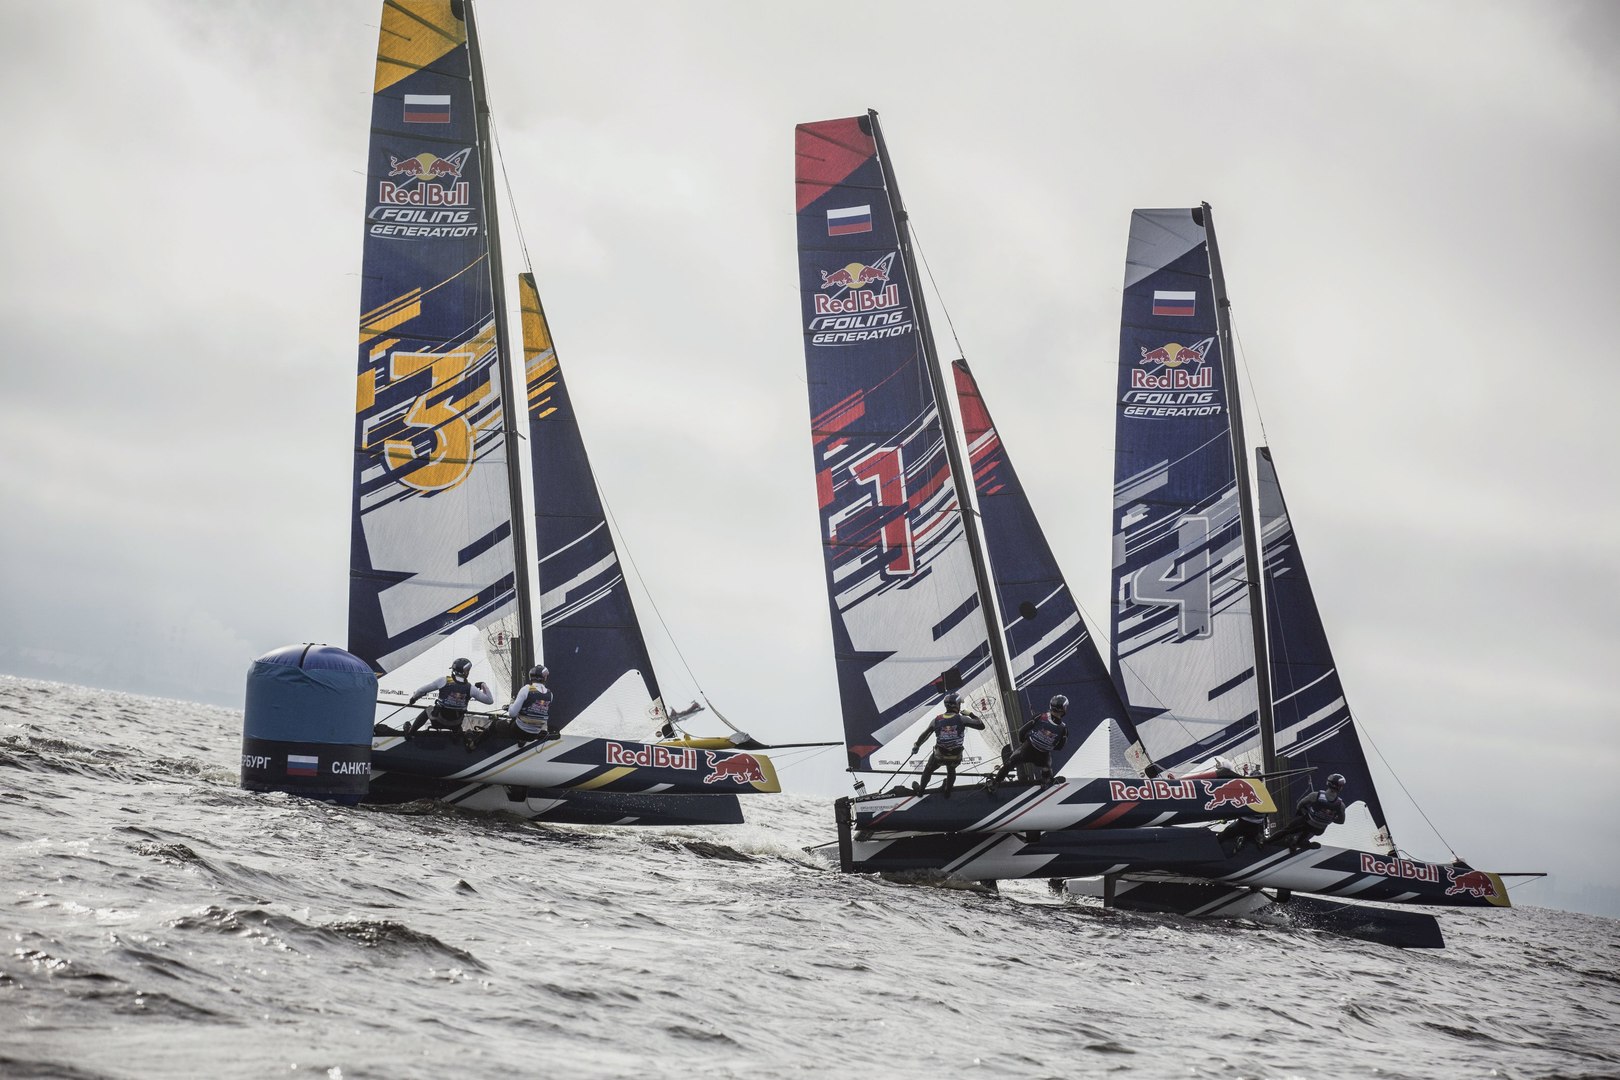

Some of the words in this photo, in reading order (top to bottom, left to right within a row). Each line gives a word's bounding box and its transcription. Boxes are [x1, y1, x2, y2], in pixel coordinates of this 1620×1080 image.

[379, 181, 426, 205] Red
[427, 181, 469, 206] Bull
[381, 209, 470, 223] FOILING
[370, 224, 477, 237] GENERATION
[814, 290, 858, 315] Red
[858, 283, 900, 312] Bull
[821, 311, 903, 330] FOILING
[812, 324, 912, 343] GENERATION
[1132, 368, 1172, 389] Red
[1173, 366, 1212, 389] Bull
[1133, 392, 1213, 404] FOILING
[1123, 405, 1221, 417] GENERATION
[384, 351, 478, 495] 3
[848, 445, 917, 577] 1
[1130, 514, 1213, 639] 4
[242, 754, 271, 769] РБУРГ
[605, 741, 652, 767] Red
[653, 747, 697, 770] Bull
[1109, 780, 1154, 801] Red
[1153, 780, 1197, 801] Bull
[1360, 852, 1400, 878] Red
[1400, 859, 1439, 883] Bull
